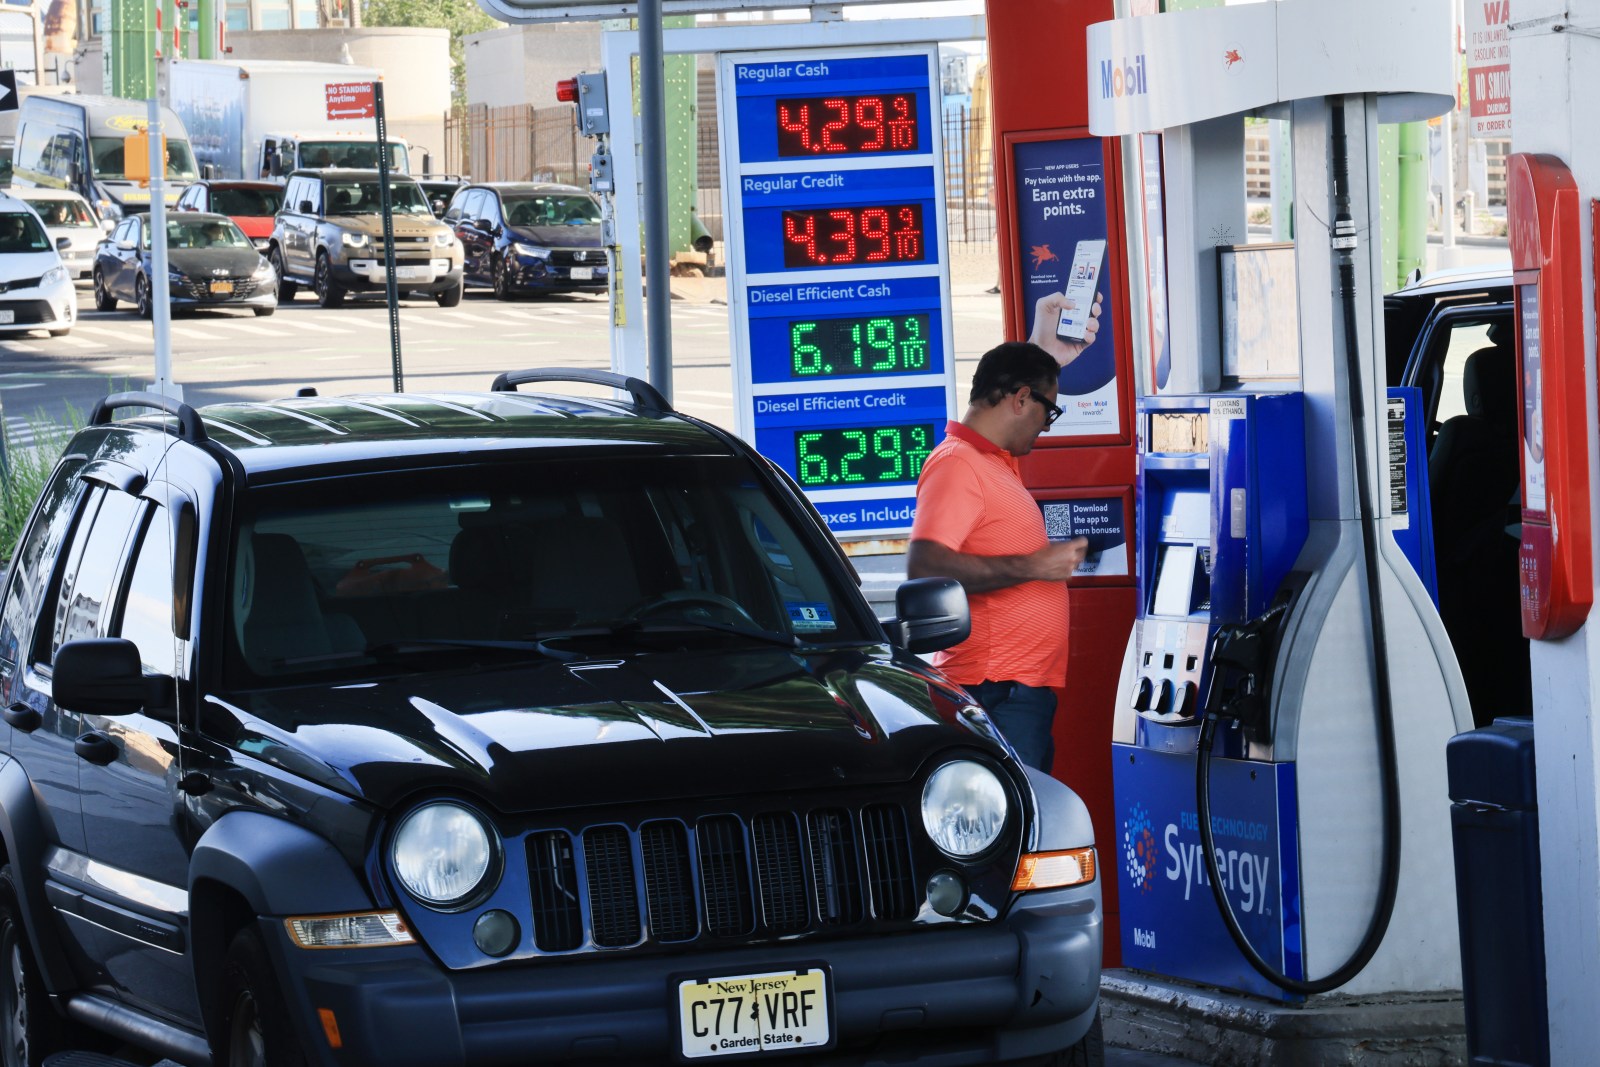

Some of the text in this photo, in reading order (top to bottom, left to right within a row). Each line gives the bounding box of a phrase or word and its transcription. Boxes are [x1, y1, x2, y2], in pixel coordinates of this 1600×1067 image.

[1474, 47, 1496, 61] GASOLINE
[738, 63, 829, 81] Regular Cash
[1100, 54, 1147, 99] Mobil
[339, 85, 370, 94] STANDING
[1475, 71, 1511, 101] NO SMOK
[329, 95, 356, 104] Anytime
[1487, 103, 1508, 114] DURING
[780, 98, 884, 152] 4.29
[1478, 122, 1484, 131] BY
[1487, 120, 1505, 130] ORDER
[744, 175, 844, 193] Regular Credit
[1025, 177, 1037, 186] Pay
[1038, 176, 1056, 184] twice
[1057, 174, 1072, 183] with
[1087, 174, 1101, 182] app.
[1032, 187, 1095, 202] Earn extra
[1043, 202, 1086, 220] points.
[786, 209, 890, 262] 4.39
[751, 284, 890, 303] Diesel Efficient Cash
[792, 319, 896, 374] 6.19
[757, 393, 906, 413] Diesel Efficient Credit
[799, 429, 902, 484] 6.29
[821, 505, 917, 524] axes Include
[1073, 504, 1108, 512] Download
[1087, 517, 1099, 525] app
[806, 608, 814, 618] 3
[1181, 812, 1268, 841] FUE ECHNOLOGY
[1164, 823, 1269, 915] Synergy
[1134, 928, 1156, 949] Mobil
[717, 979, 788, 995] New Jersey
[691, 990, 816, 1038] C77 VRF
[720, 1033, 793, 1048] Garden State
